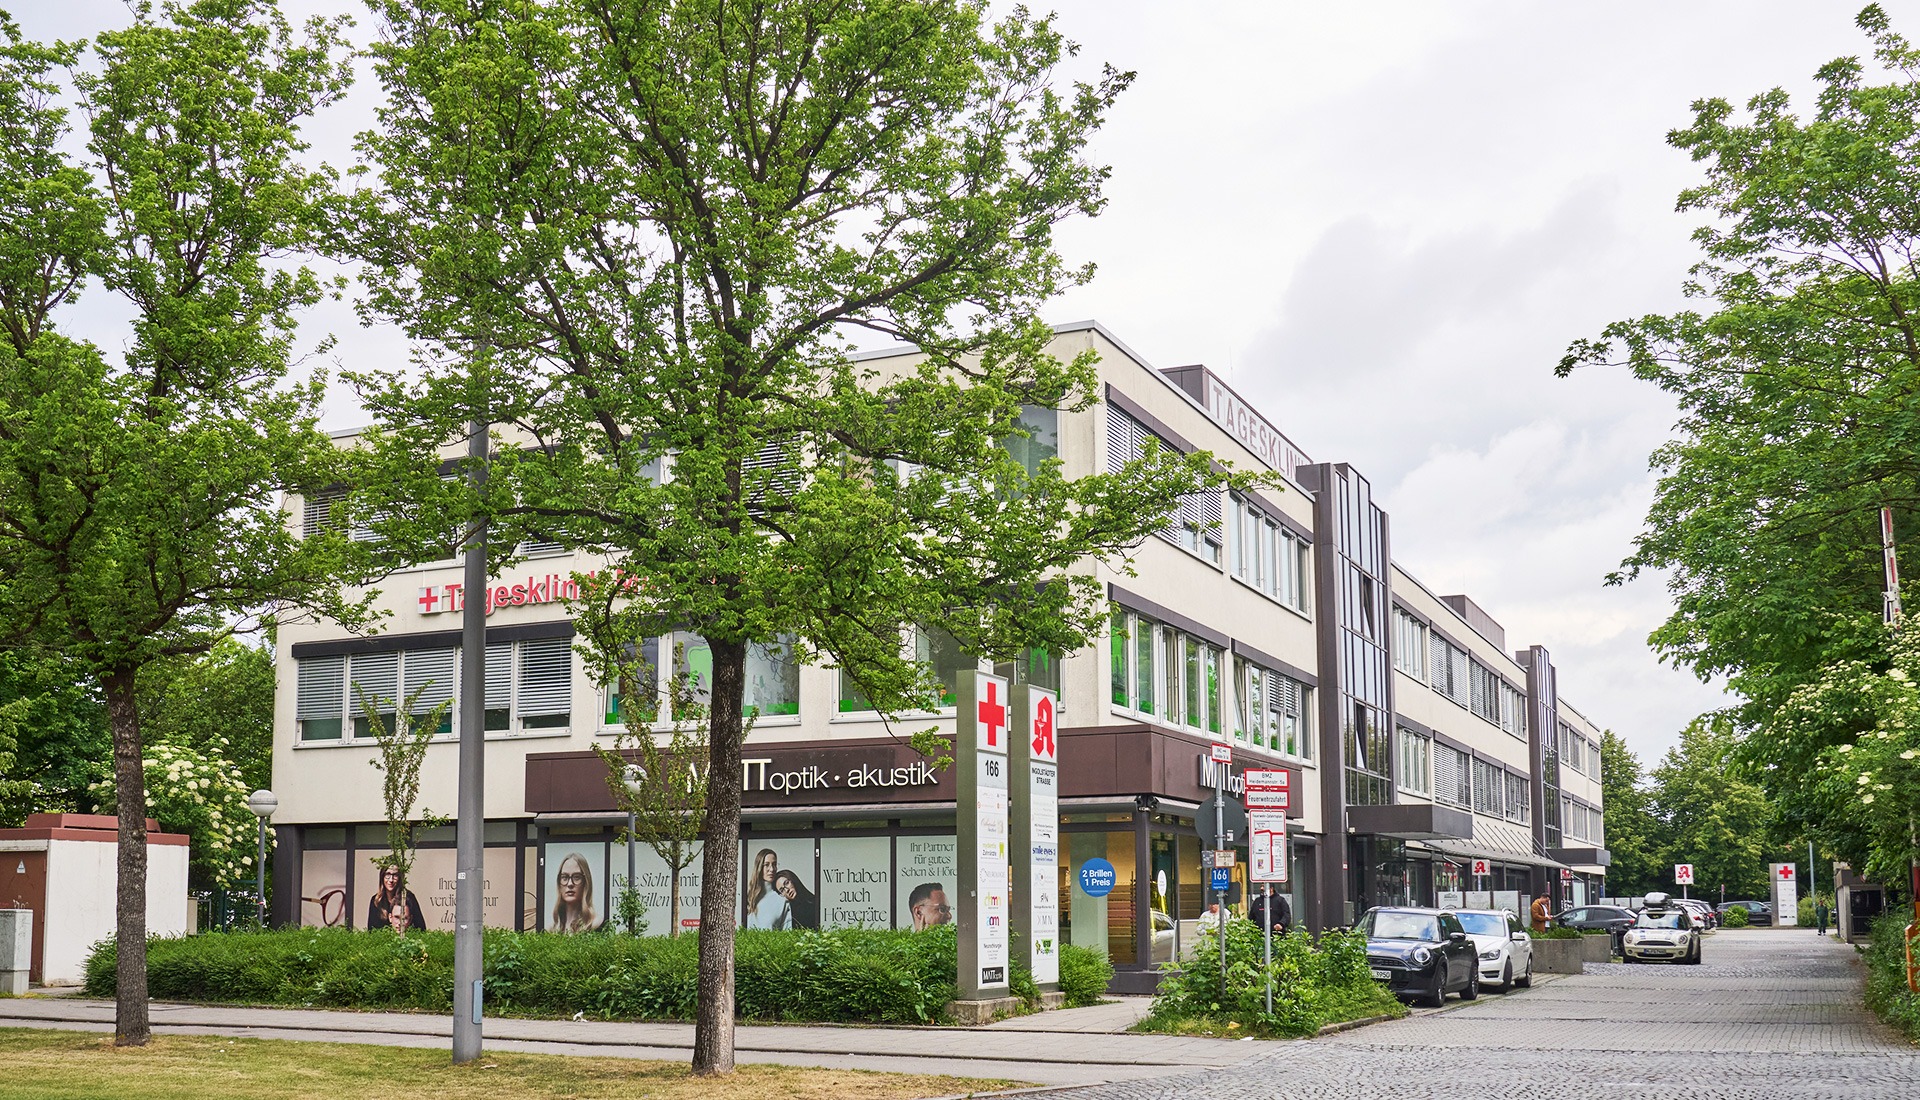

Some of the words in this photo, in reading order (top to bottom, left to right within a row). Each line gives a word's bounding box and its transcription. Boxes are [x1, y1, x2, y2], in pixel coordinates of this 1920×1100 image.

[1213, 385, 1303, 480] TAGESKLIN
[847, 761, 939, 788] akustik
[985, 760, 999, 778] 166
[1036, 776, 1051, 786] STRASSE
[910, 843, 921, 852] Ihr
[923, 843, 955, 852] Partner
[914, 855, 926, 865] für
[928, 855, 952, 866] gutes
[823, 868, 845, 883] Wir
[847, 868, 887, 883] haben
[901, 867, 927, 877] Sehen
[928, 868, 936, 877] &
[937, 867, 957, 877] Höre
[1082, 869, 1088, 878] 2
[1089, 869, 1113, 878] Brillen
[1212, 869, 1228, 880] 166
[641, 872, 671, 888] Sicht
[680, 872, 700, 888] mit
[1085, 878, 1089, 886] 1
[1091, 878, 1111, 886] Preis
[839, 887, 871, 903] auch
[824, 907, 888, 925] Hörgeräte
